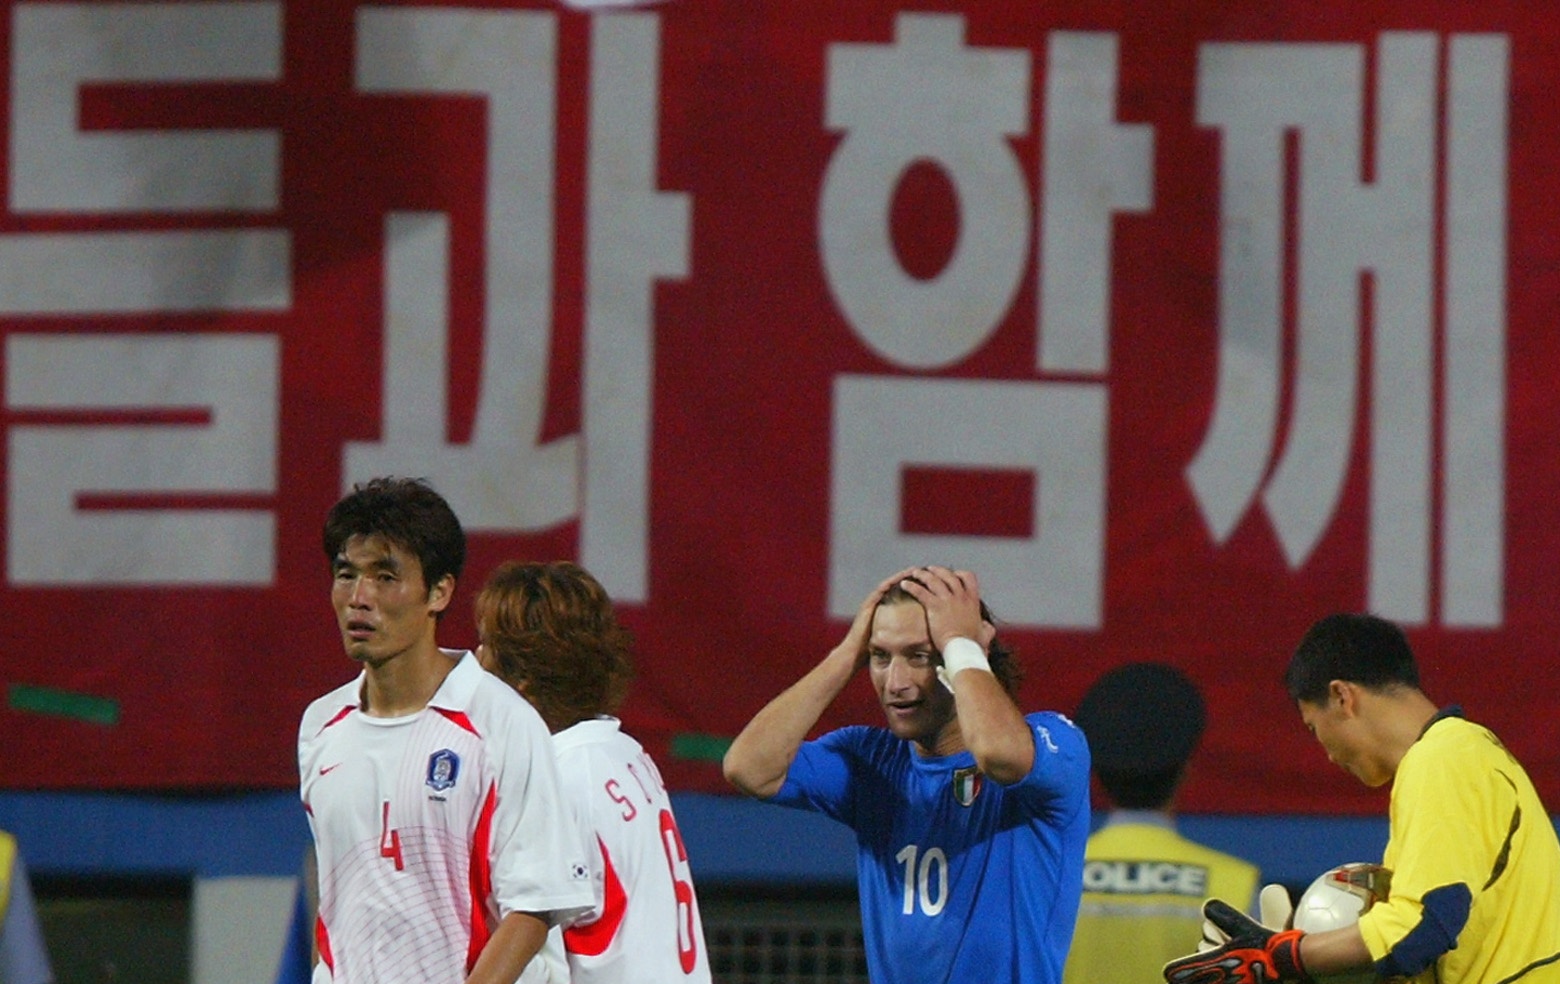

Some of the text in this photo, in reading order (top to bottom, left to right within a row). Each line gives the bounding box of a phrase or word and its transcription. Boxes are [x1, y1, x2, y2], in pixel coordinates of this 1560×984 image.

[0, 0, 693, 605] 들과
[816, 12, 1511, 630] 함께
[380, 801, 404, 871] 4
[659, 808, 697, 975] 6
[895, 844, 948, 917] 10
[1083, 862, 1206, 895] OLICE
